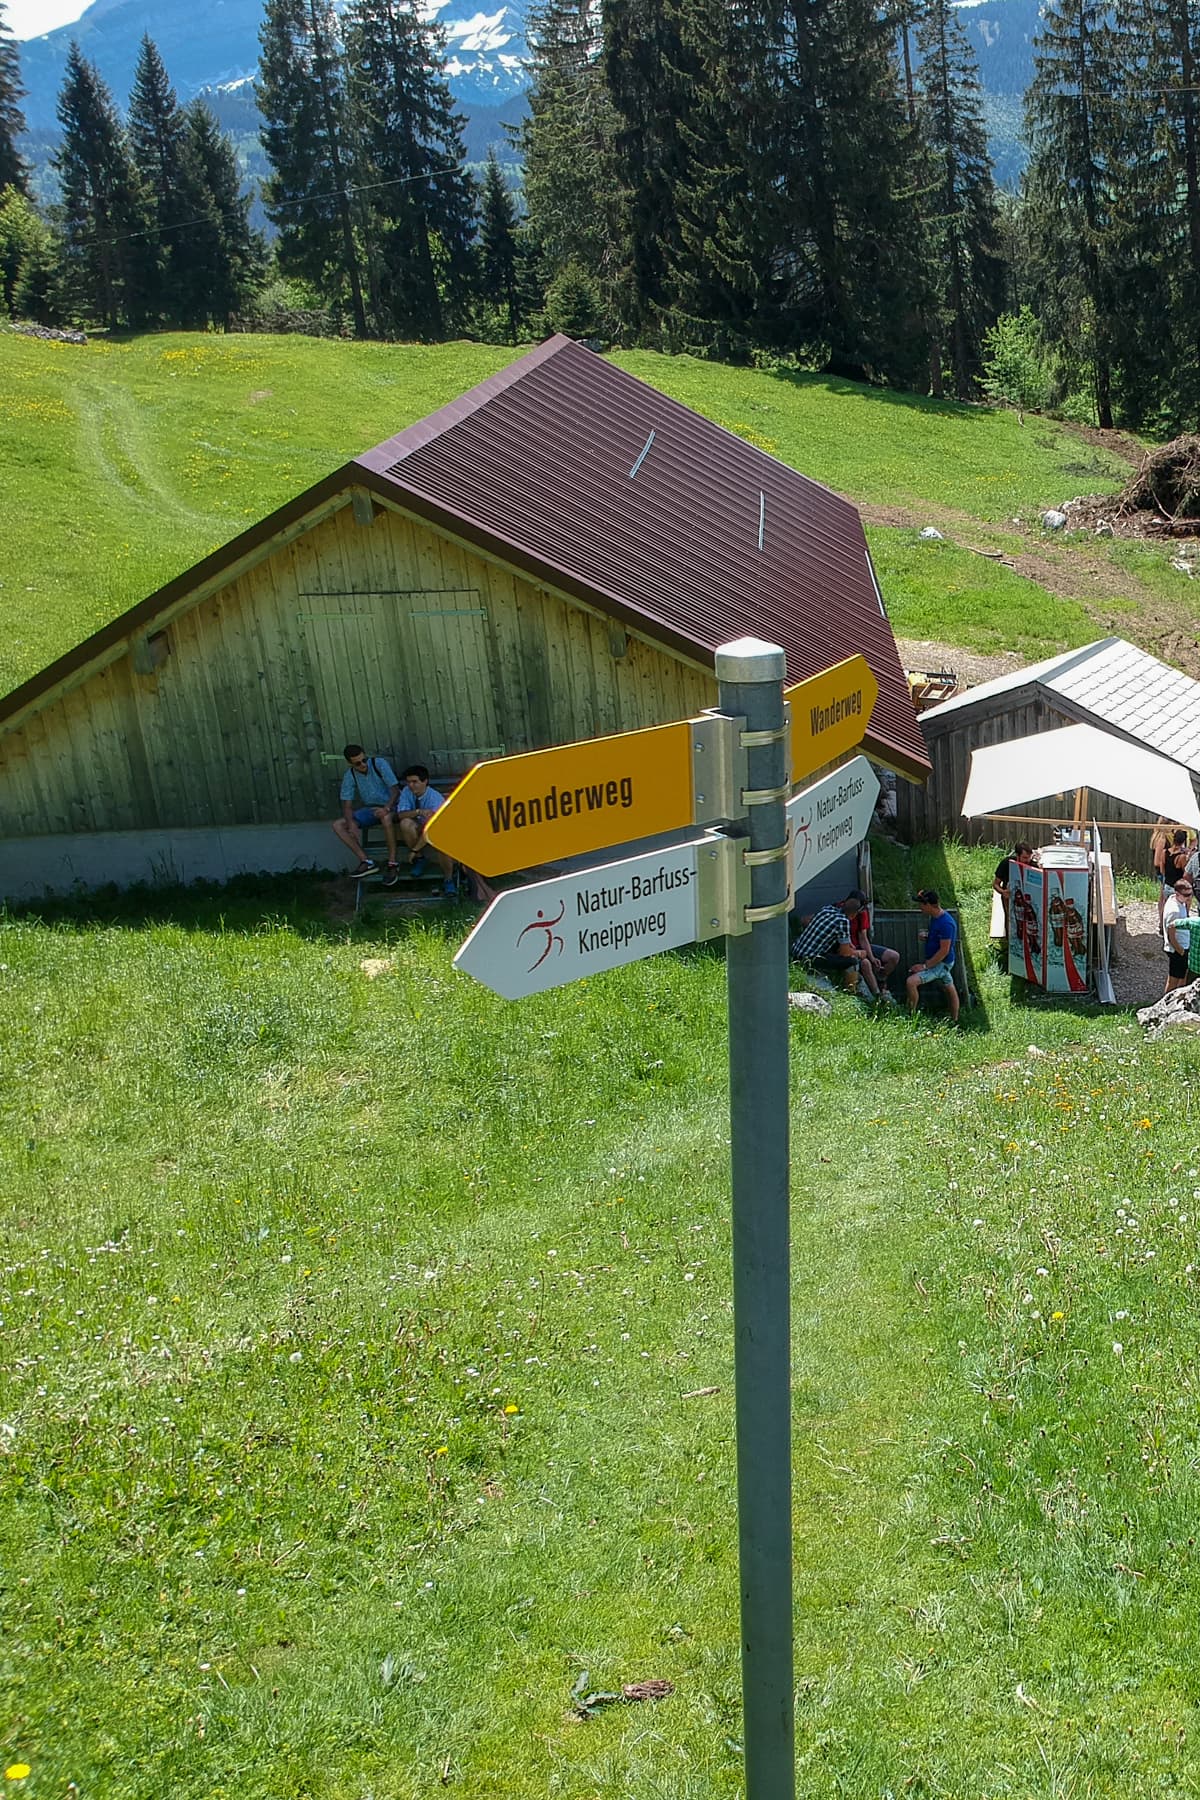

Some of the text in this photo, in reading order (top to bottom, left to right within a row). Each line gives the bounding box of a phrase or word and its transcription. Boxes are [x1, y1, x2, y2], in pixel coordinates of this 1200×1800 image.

[810, 689, 862, 736] Wanderweg
[487, 777, 633, 834] Wanderweg
[816, 776, 865, 822] Natur-Barfuss-
[817, 815, 853, 853] Kneippweg
[576, 866, 697, 916] Natur-Barfuss-
[578, 911, 666, 954] Kneippweg
